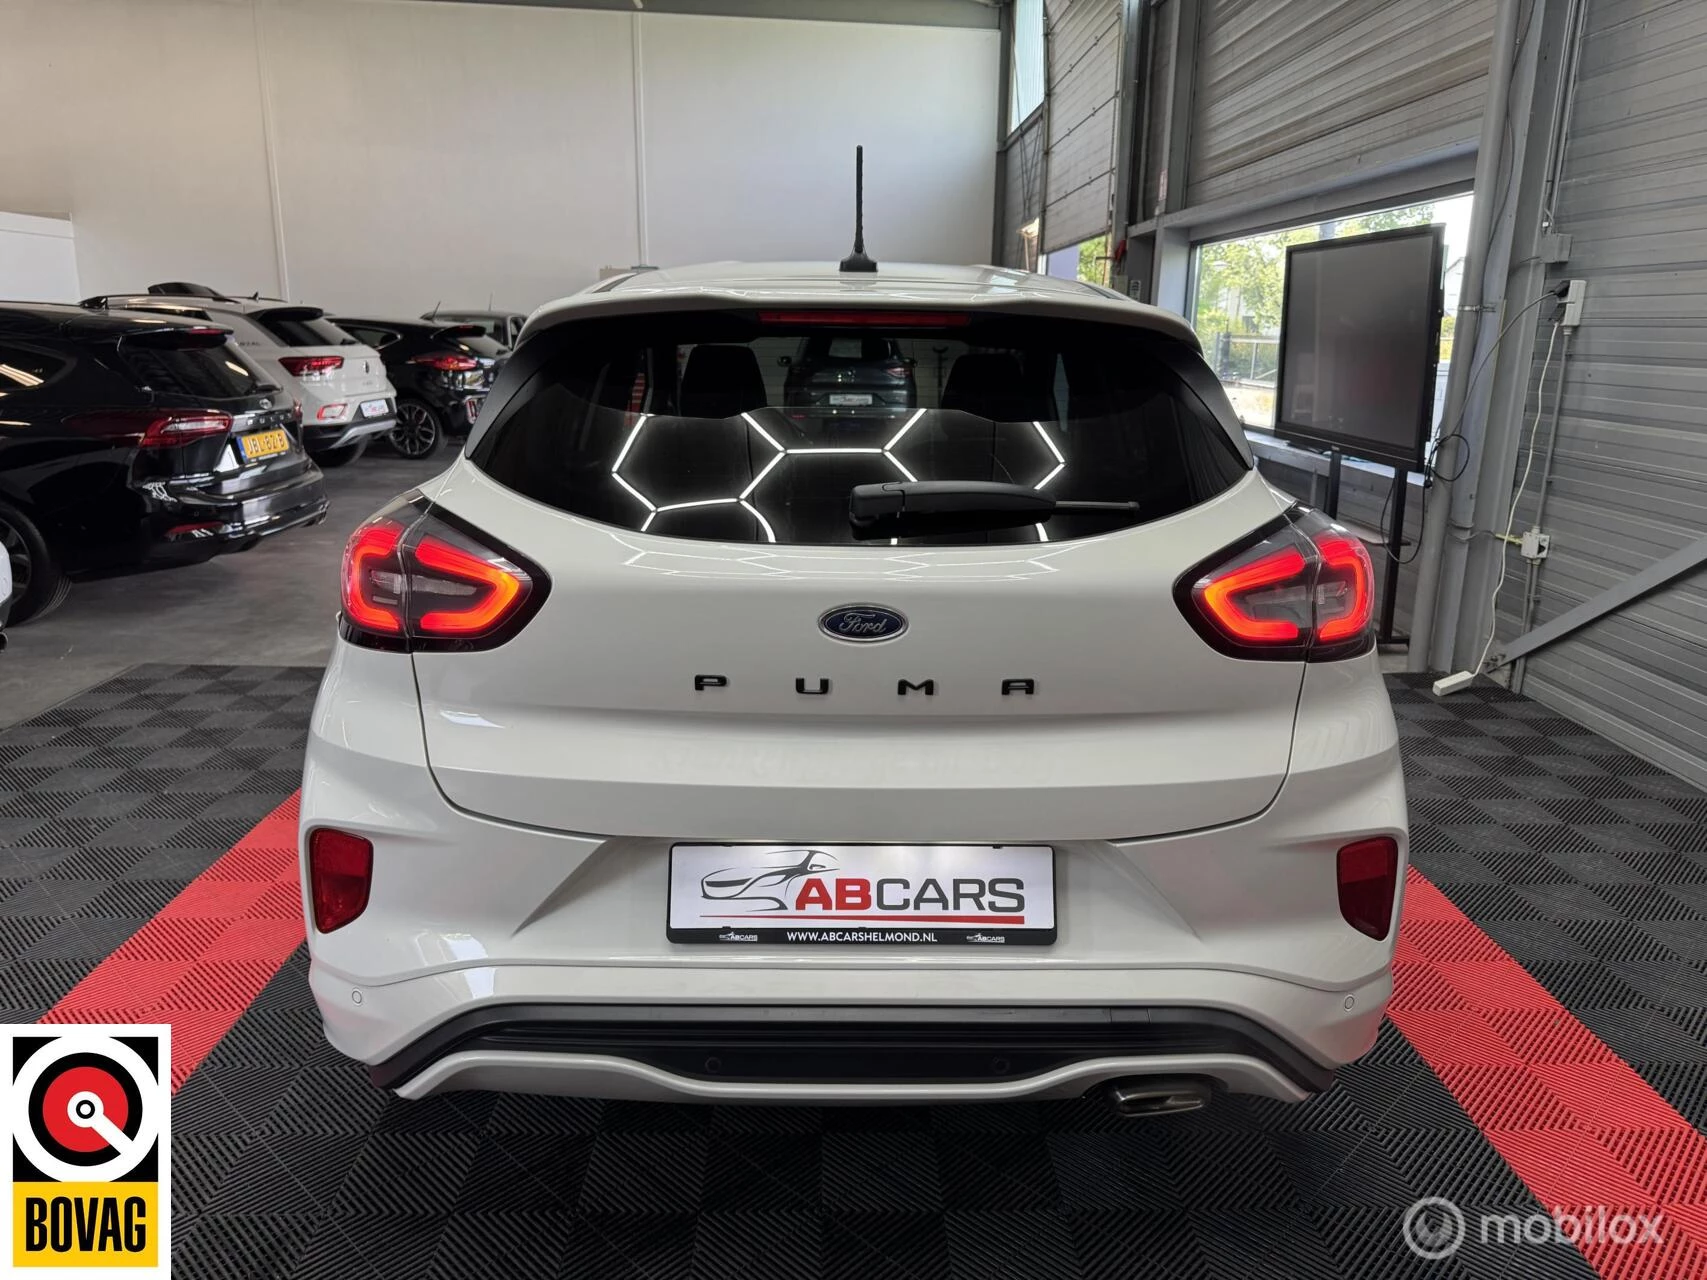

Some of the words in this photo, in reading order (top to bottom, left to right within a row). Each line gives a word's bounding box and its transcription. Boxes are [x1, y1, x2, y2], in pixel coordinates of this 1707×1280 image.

[839, 611, 887, 634] Ford
[694, 674, 1035, 696] PUMA
[795, 878, 1025, 913] ABCARS
[787, 931, 938, 942] WWW.ABCARSHELMOND.NL
